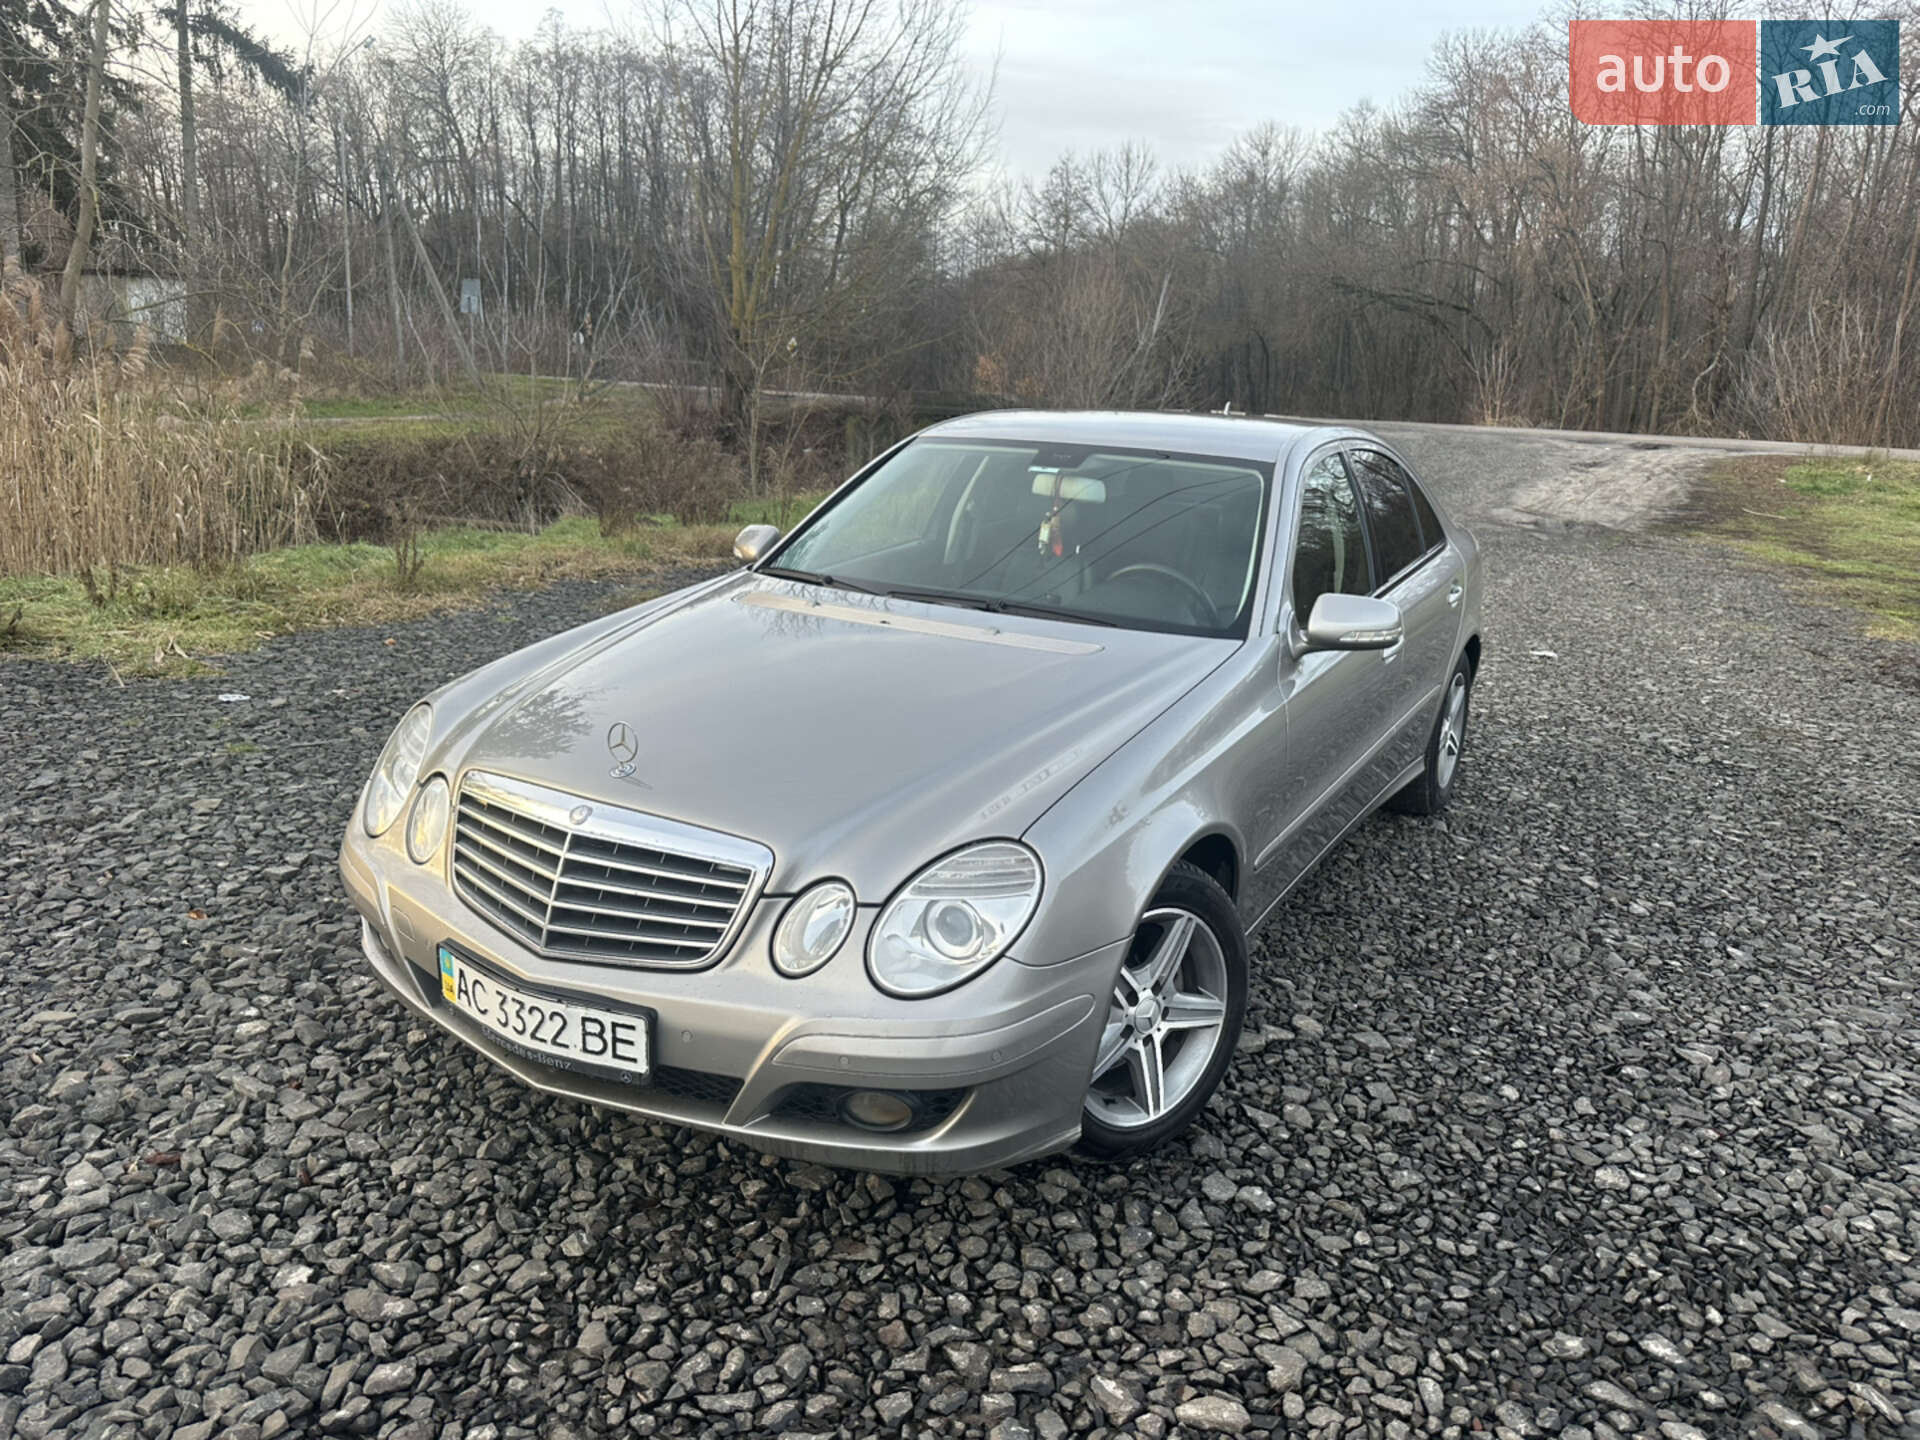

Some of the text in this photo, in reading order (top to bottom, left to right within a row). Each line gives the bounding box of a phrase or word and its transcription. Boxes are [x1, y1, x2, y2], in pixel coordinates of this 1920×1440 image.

[457, 967, 638, 1064] AC 3322 BE
